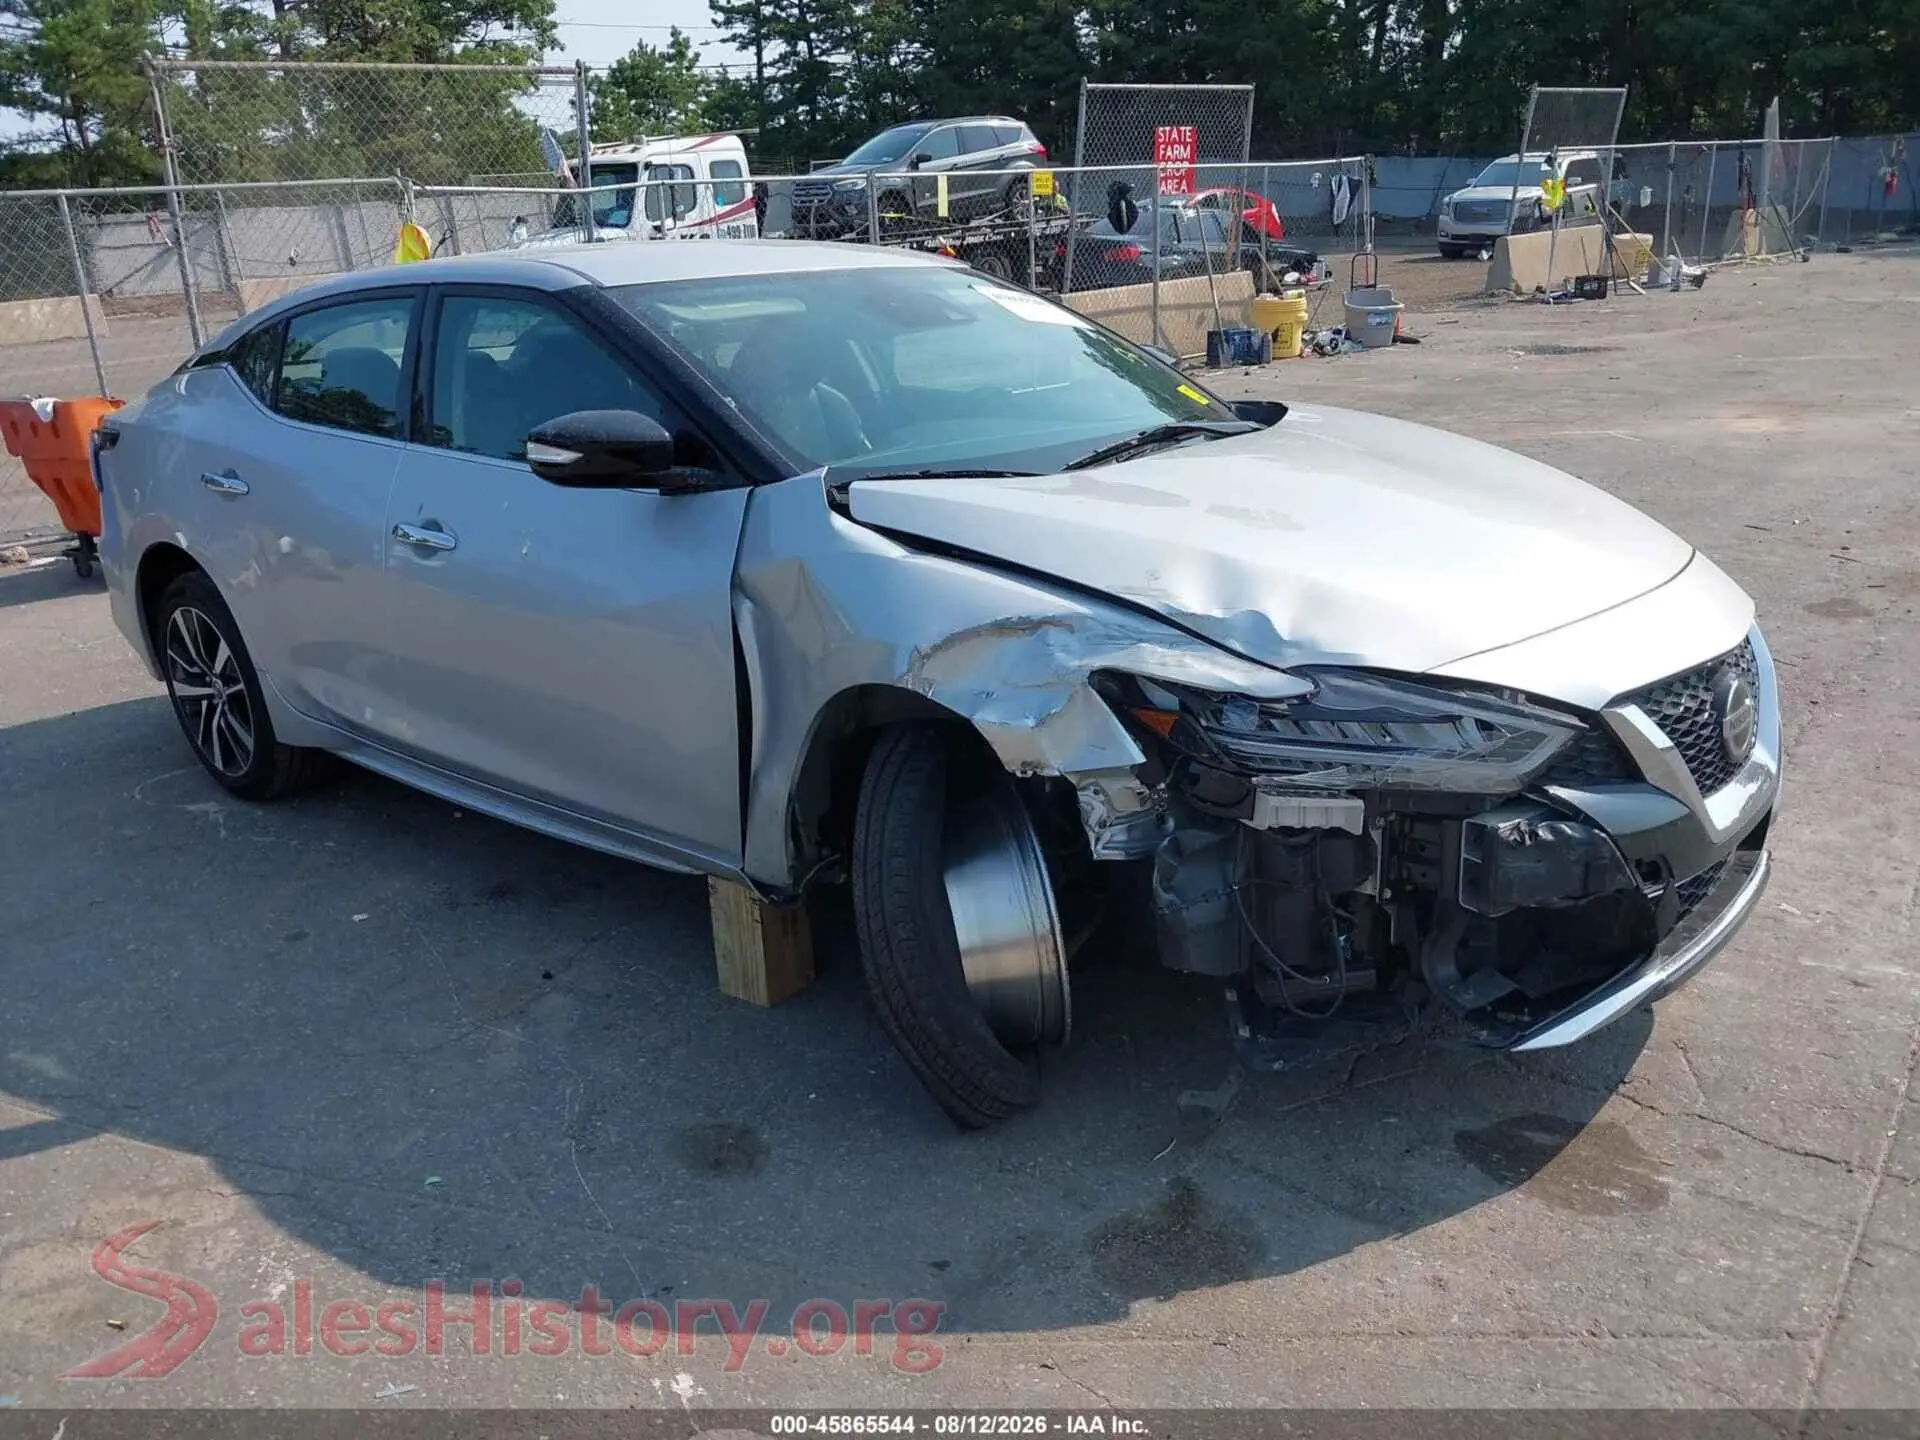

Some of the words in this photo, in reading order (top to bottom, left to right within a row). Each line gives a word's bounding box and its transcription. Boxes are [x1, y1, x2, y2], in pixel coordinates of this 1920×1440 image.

[1158, 126, 1192, 142] STATE
[1159, 144, 1191, 160] FARM
[1159, 178, 1188, 194] AREA
